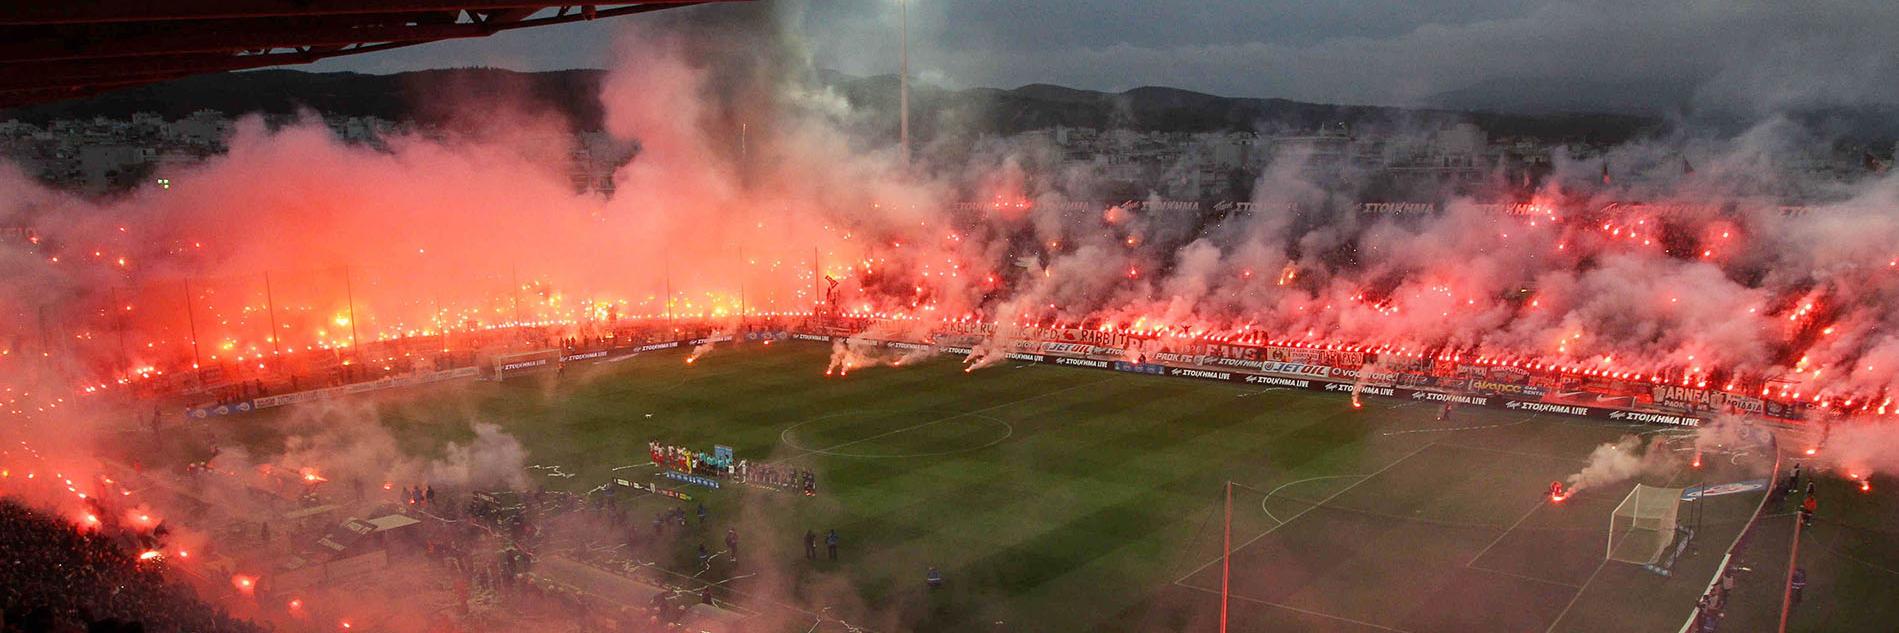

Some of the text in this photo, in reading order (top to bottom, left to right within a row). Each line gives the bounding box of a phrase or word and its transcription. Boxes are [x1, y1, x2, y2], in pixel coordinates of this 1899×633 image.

[1471, 395, 1487, 406] LIVE
[1571, 406, 1588, 416] LIVE
[1681, 416, 1700, 427] LIVE
